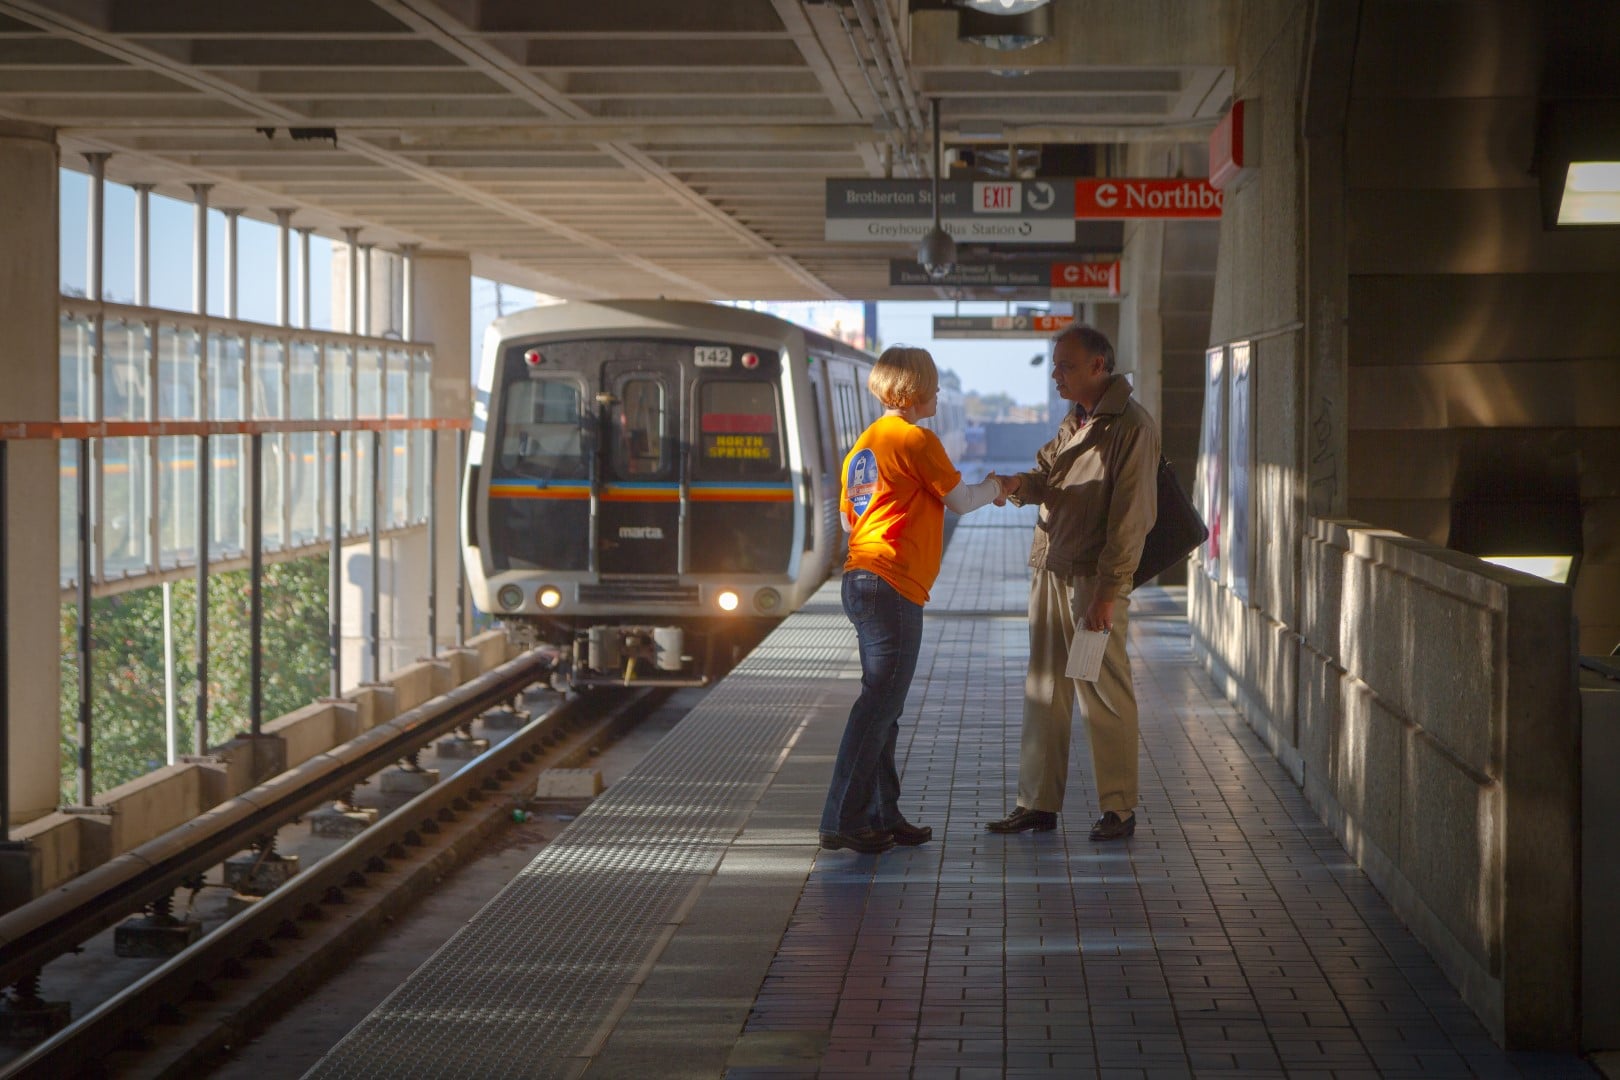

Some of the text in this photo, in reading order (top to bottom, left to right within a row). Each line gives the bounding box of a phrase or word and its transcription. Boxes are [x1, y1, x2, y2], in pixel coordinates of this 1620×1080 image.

[846, 189, 957, 204] Brotherton Steet
[983, 186, 1013, 208] EXIT
[868, 221, 933, 238] Greyhoun
[972, 221, 1016, 235] Station
[697, 349, 729, 362] 142
[716, 435, 764, 447] NORTH
[709, 447, 771, 459] SPRINGS
[618, 525, 664, 539] marta
